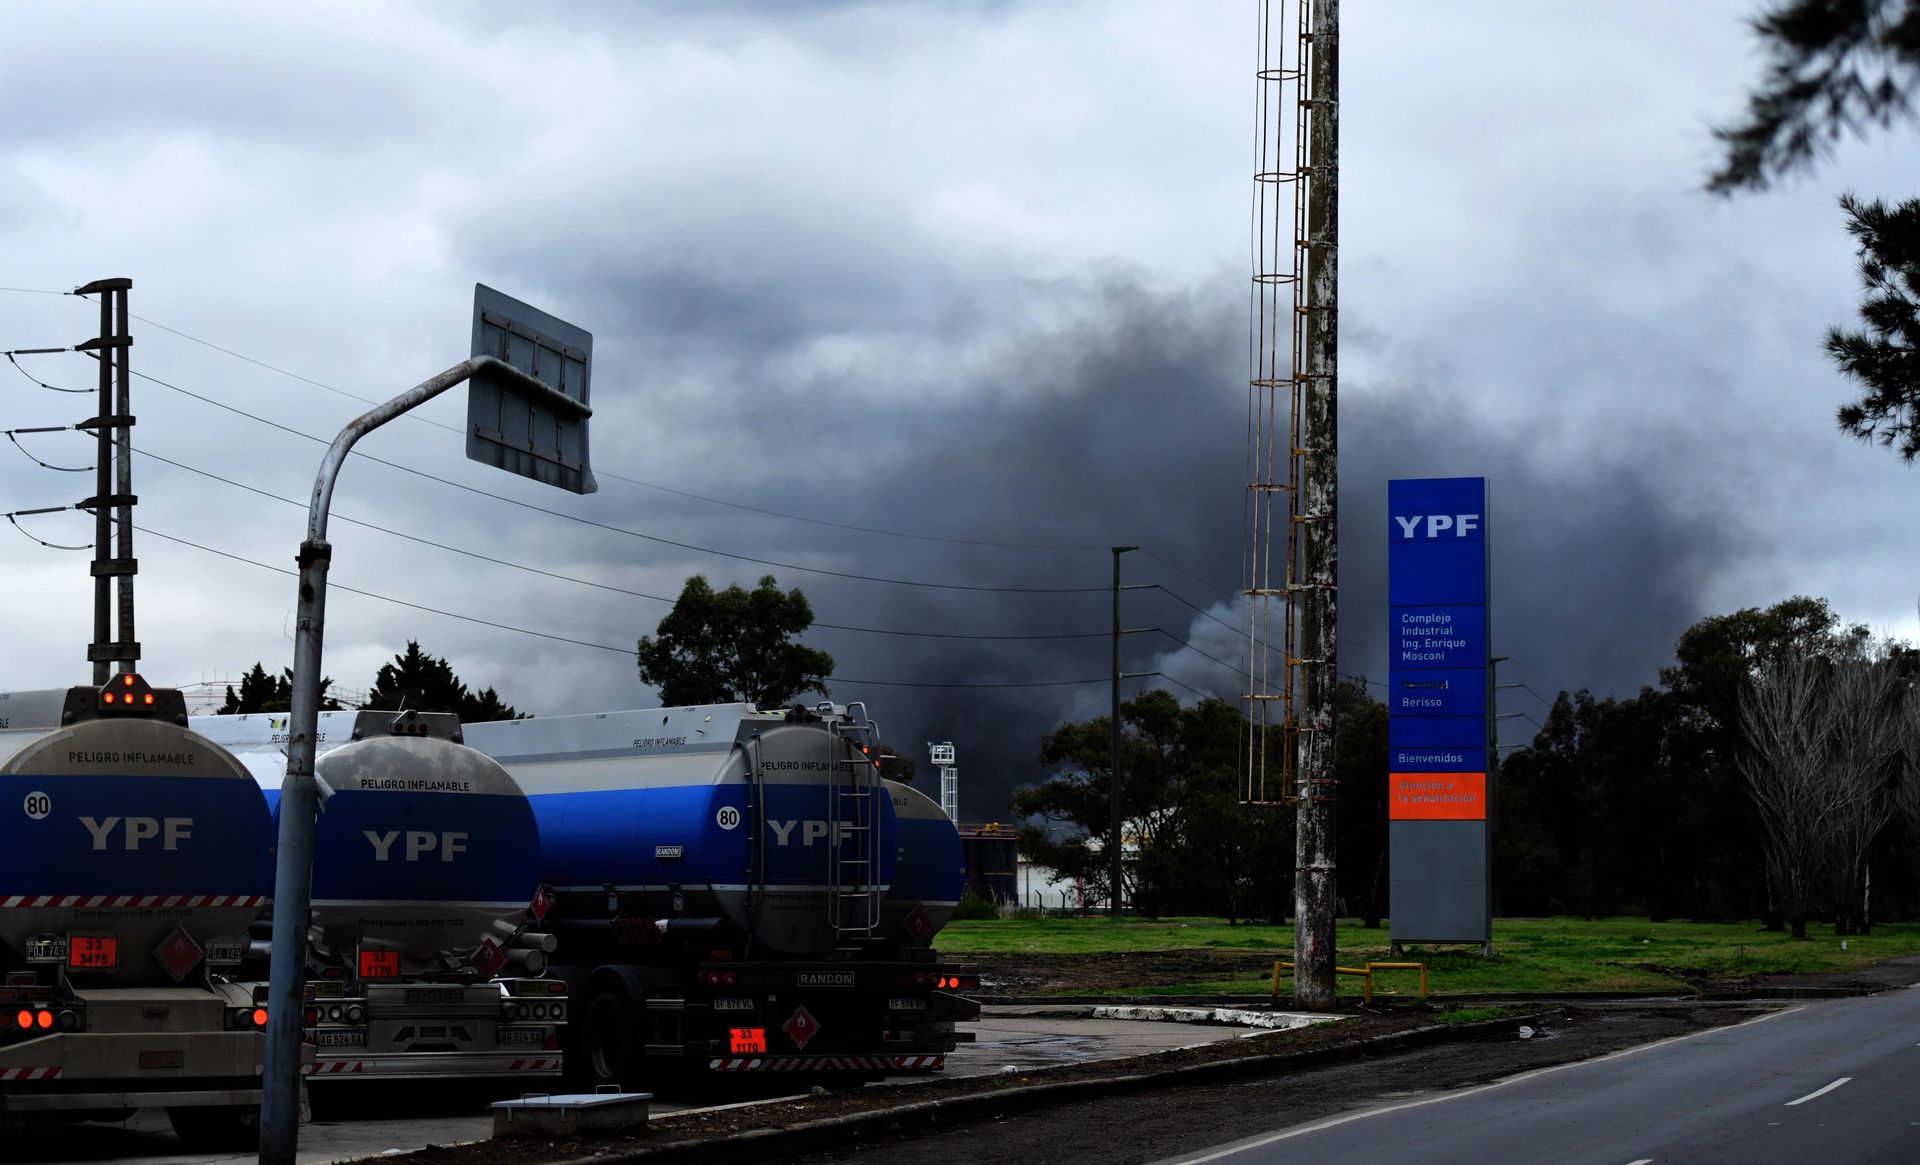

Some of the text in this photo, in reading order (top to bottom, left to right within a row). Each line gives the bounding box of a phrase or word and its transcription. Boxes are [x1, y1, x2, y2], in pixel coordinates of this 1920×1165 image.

[1394, 514, 1479, 538] YPF
[1402, 613, 1451, 624] Complejo
[1402, 625, 1453, 635] Industrial
[1402, 638, 1466, 650] Ing. Enrique
[1402, 650, 1445, 660] Mosconi
[1402, 697, 1442, 707] Berisso
[633, 737, 687, 748] PELIGRO INFLAMABLE
[69, 752, 195, 765] PELIGRO INFLAMABLE
[1398, 753, 1463, 763] Bienvenidos
[361, 779, 470, 791] PELIGRO INFLAMABLE
[27, 796, 49, 814] 80
[720, 810, 737, 825] 80
[78, 816, 193, 850] YPF
[766, 820, 853, 847] YPF
[361, 830, 468, 862] YPF
[657, 847, 679, 856] RANDON
[49, 946, 65, 957] 749
[373, 952, 386, 962] 33
[79, 954, 108, 964] 3475
[368, 965, 392, 976] 1170
[800, 974, 852, 984] RANDON
[321, 1034, 332, 1045] AG
[740, 1030, 752, 1040] 33
[736, 1042, 759, 1053] 1170
